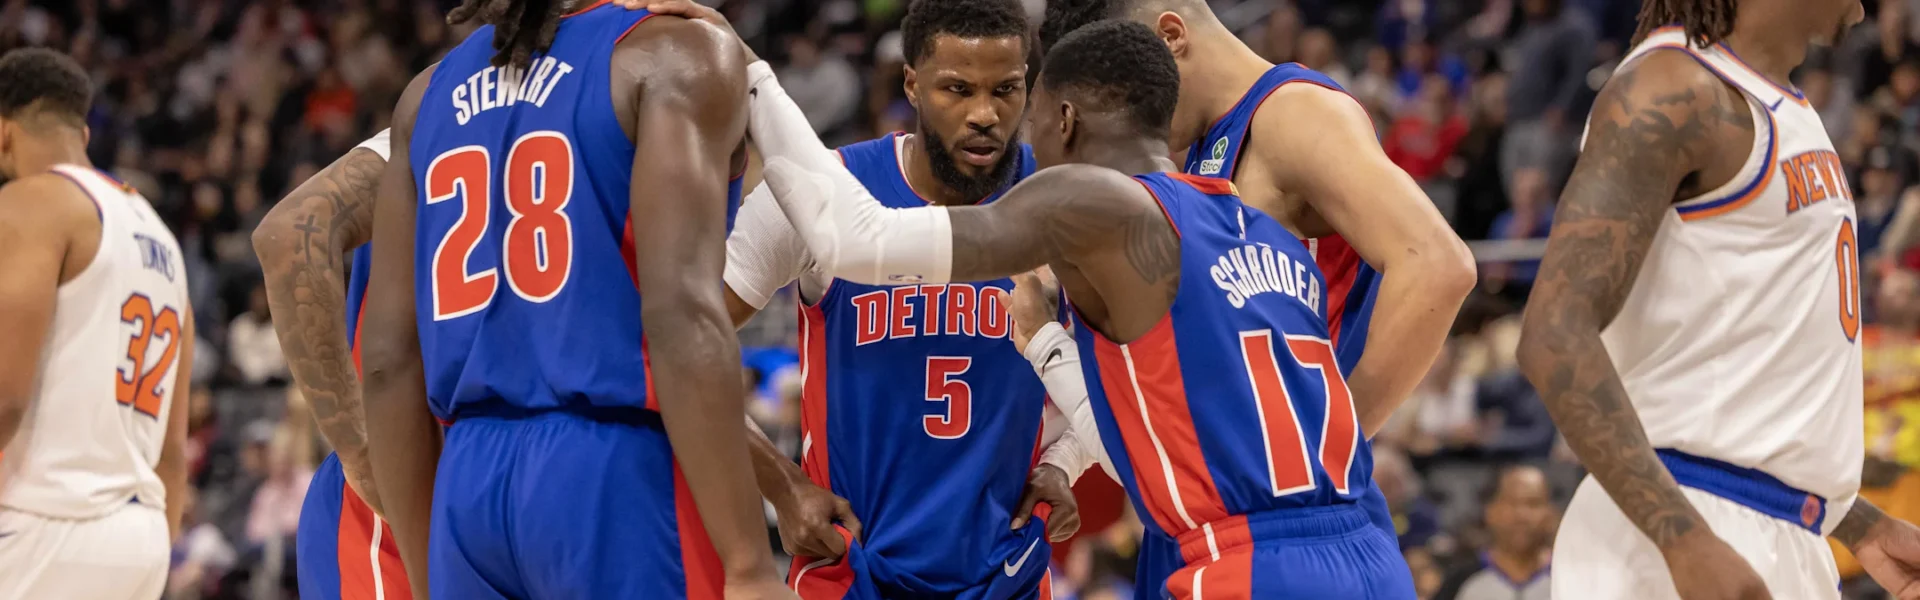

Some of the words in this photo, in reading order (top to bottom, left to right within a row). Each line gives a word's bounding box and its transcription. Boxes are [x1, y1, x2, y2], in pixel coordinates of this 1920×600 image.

[425, 130, 575, 322] 28
[1835, 215, 1860, 345] 0
[115, 291, 181, 421] 32
[850, 283, 1017, 347] DETRO
[922, 356, 972, 440] 5
[1238, 328, 1359, 498] 17
